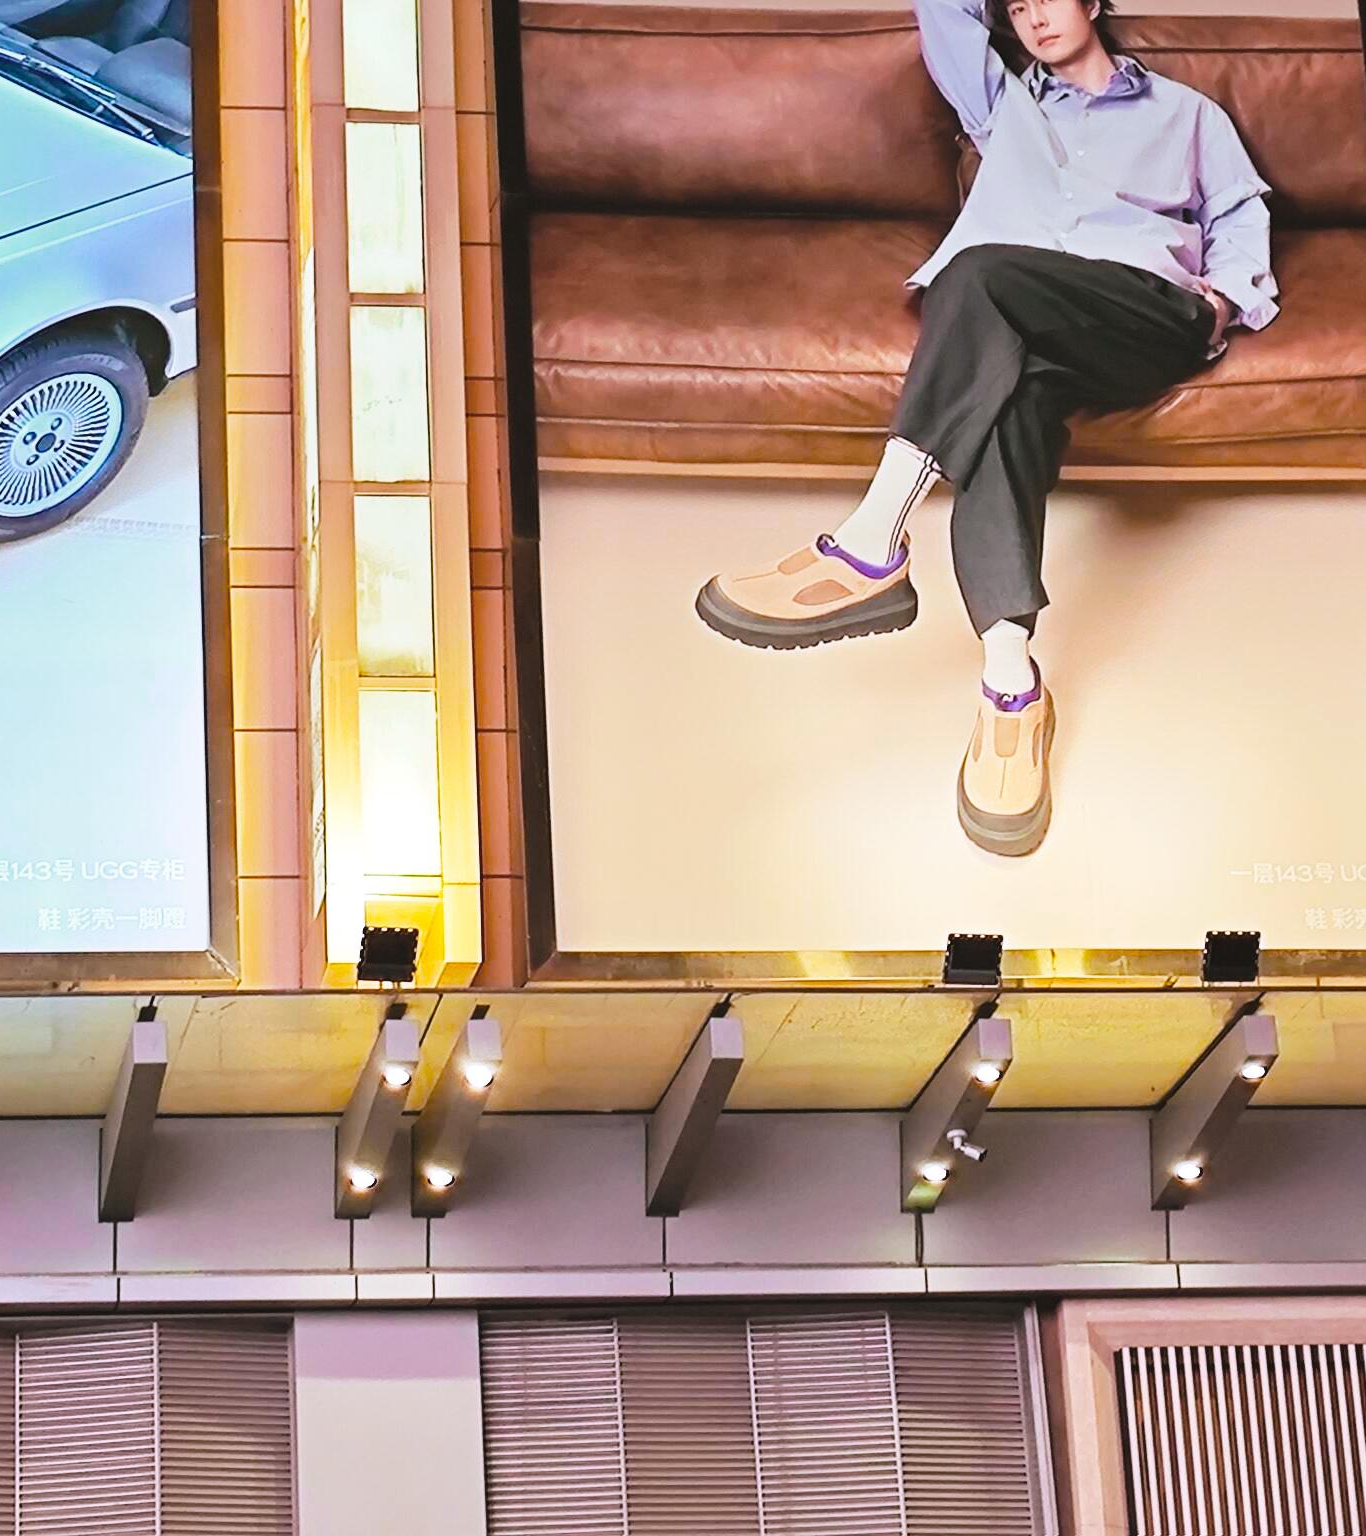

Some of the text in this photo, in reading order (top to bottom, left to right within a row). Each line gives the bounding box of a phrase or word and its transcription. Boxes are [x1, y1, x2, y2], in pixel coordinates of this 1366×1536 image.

[81, 859, 186, 881] UGG专柜
[1228, 862, 1335, 884] 一层143号
